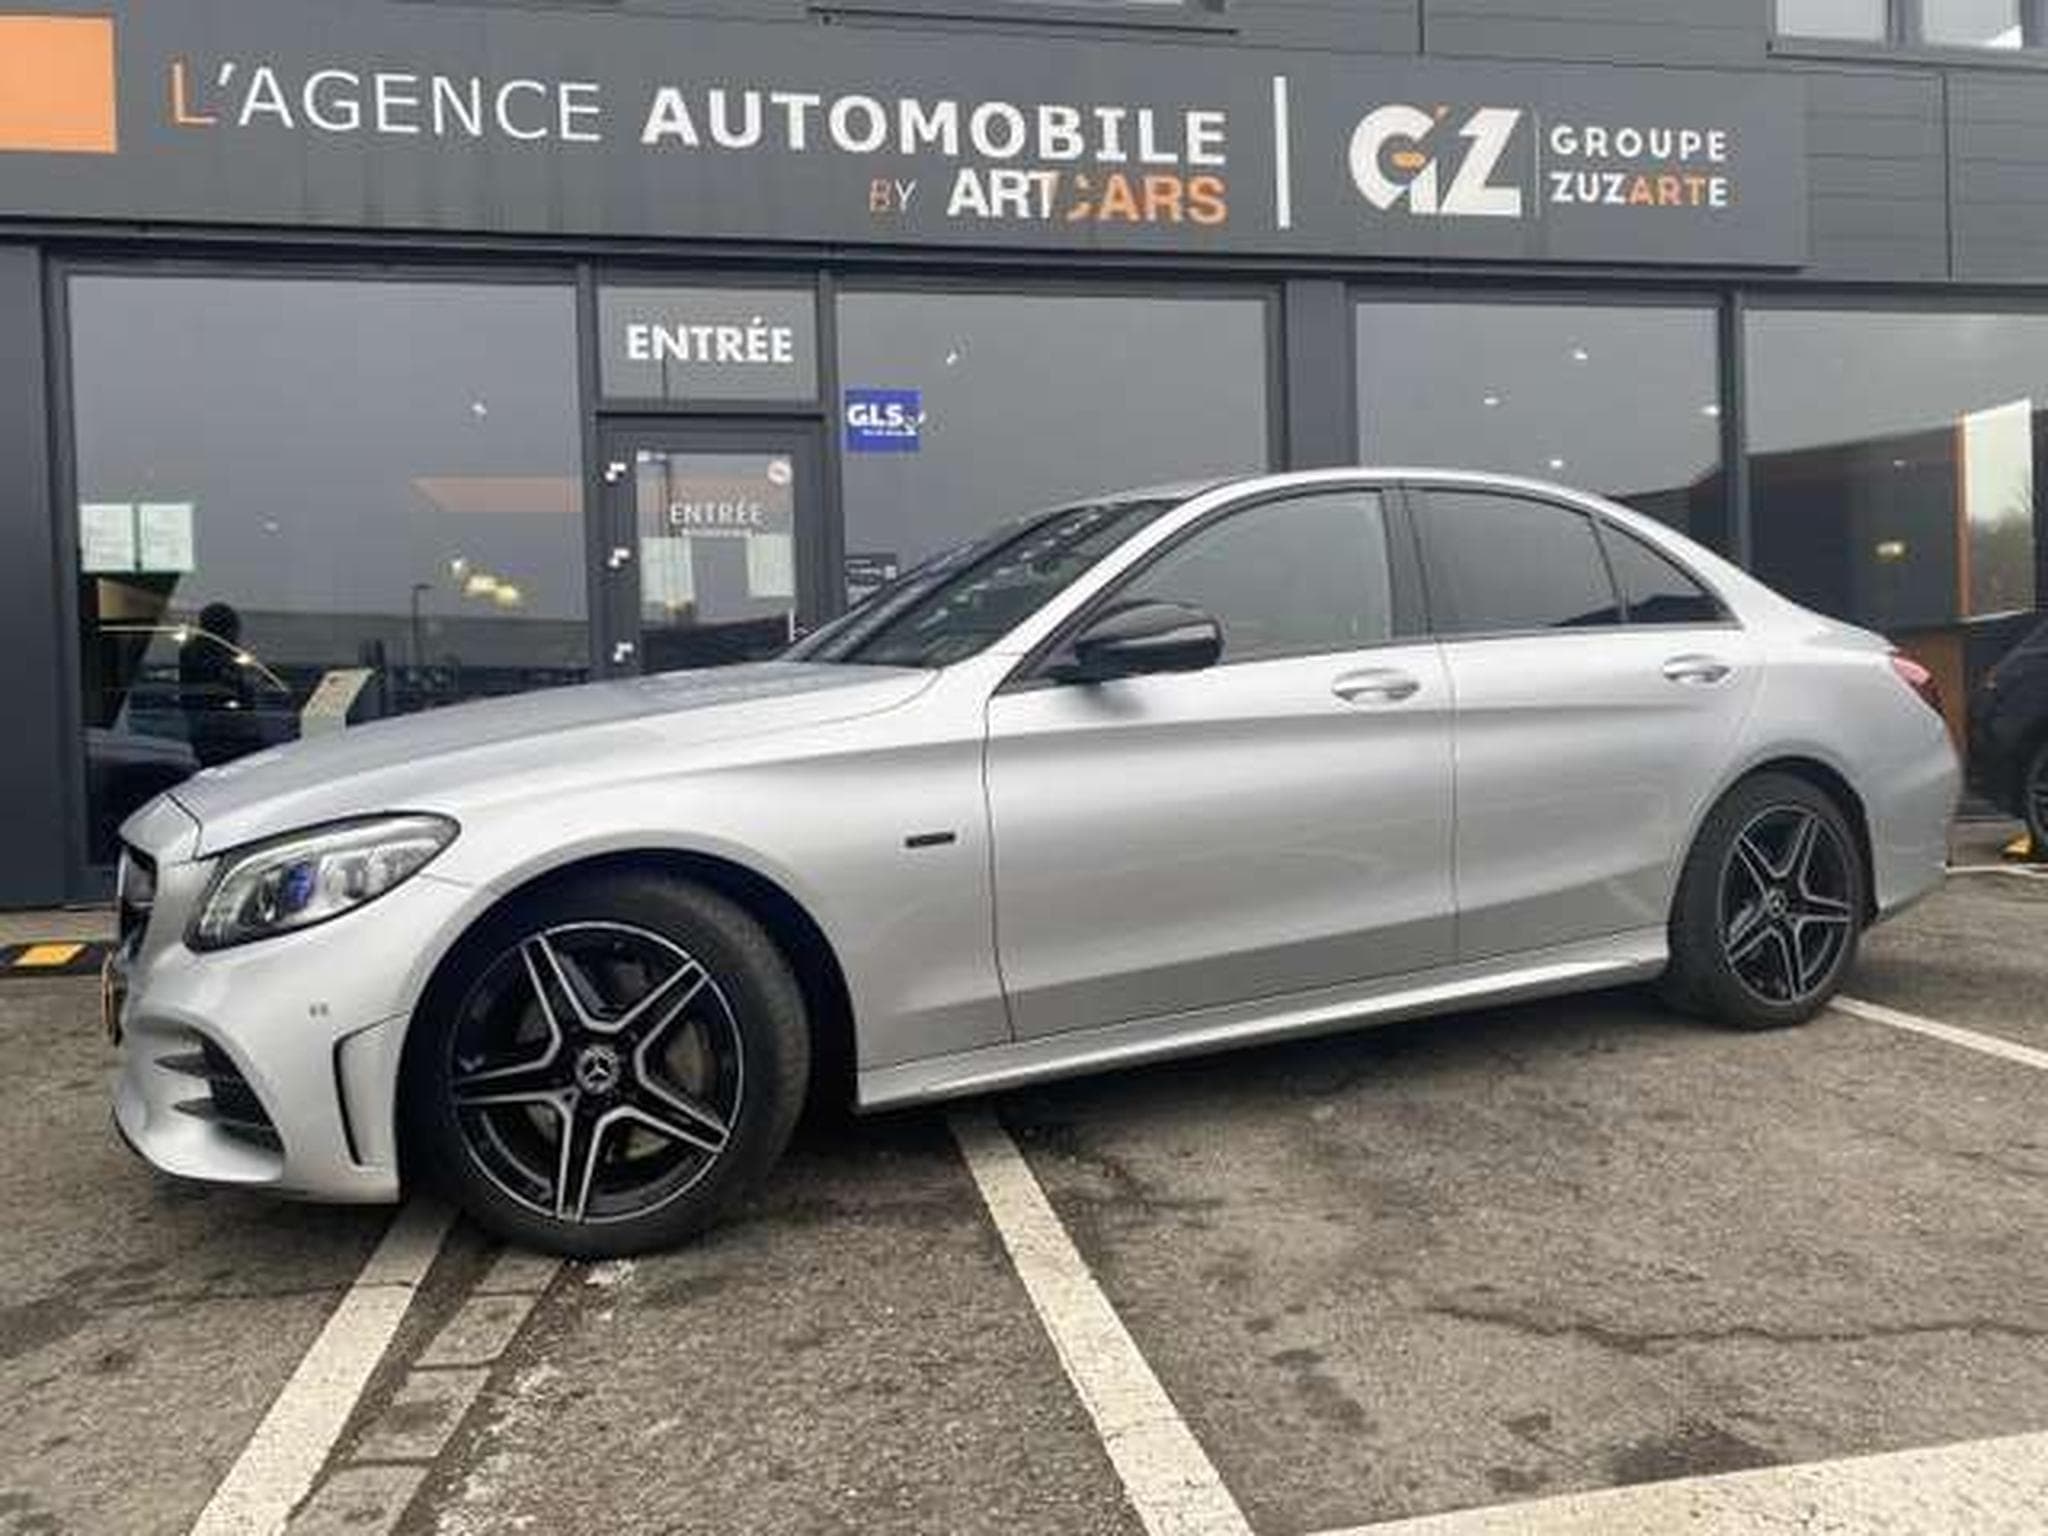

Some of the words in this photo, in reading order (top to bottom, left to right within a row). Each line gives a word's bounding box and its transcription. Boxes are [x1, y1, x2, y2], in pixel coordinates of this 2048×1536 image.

[641, 87, 1227, 165] AUTOMOBILE
[1550, 126, 1728, 161] GROUPE
[869, 177, 917, 214] BY
[1549, 171, 1729, 208] ZUZARTE
[626, 315, 794, 363] ENTRÉE
[848, 403, 903, 427] GLS
[670, 496, 764, 525] ENTRÉE
